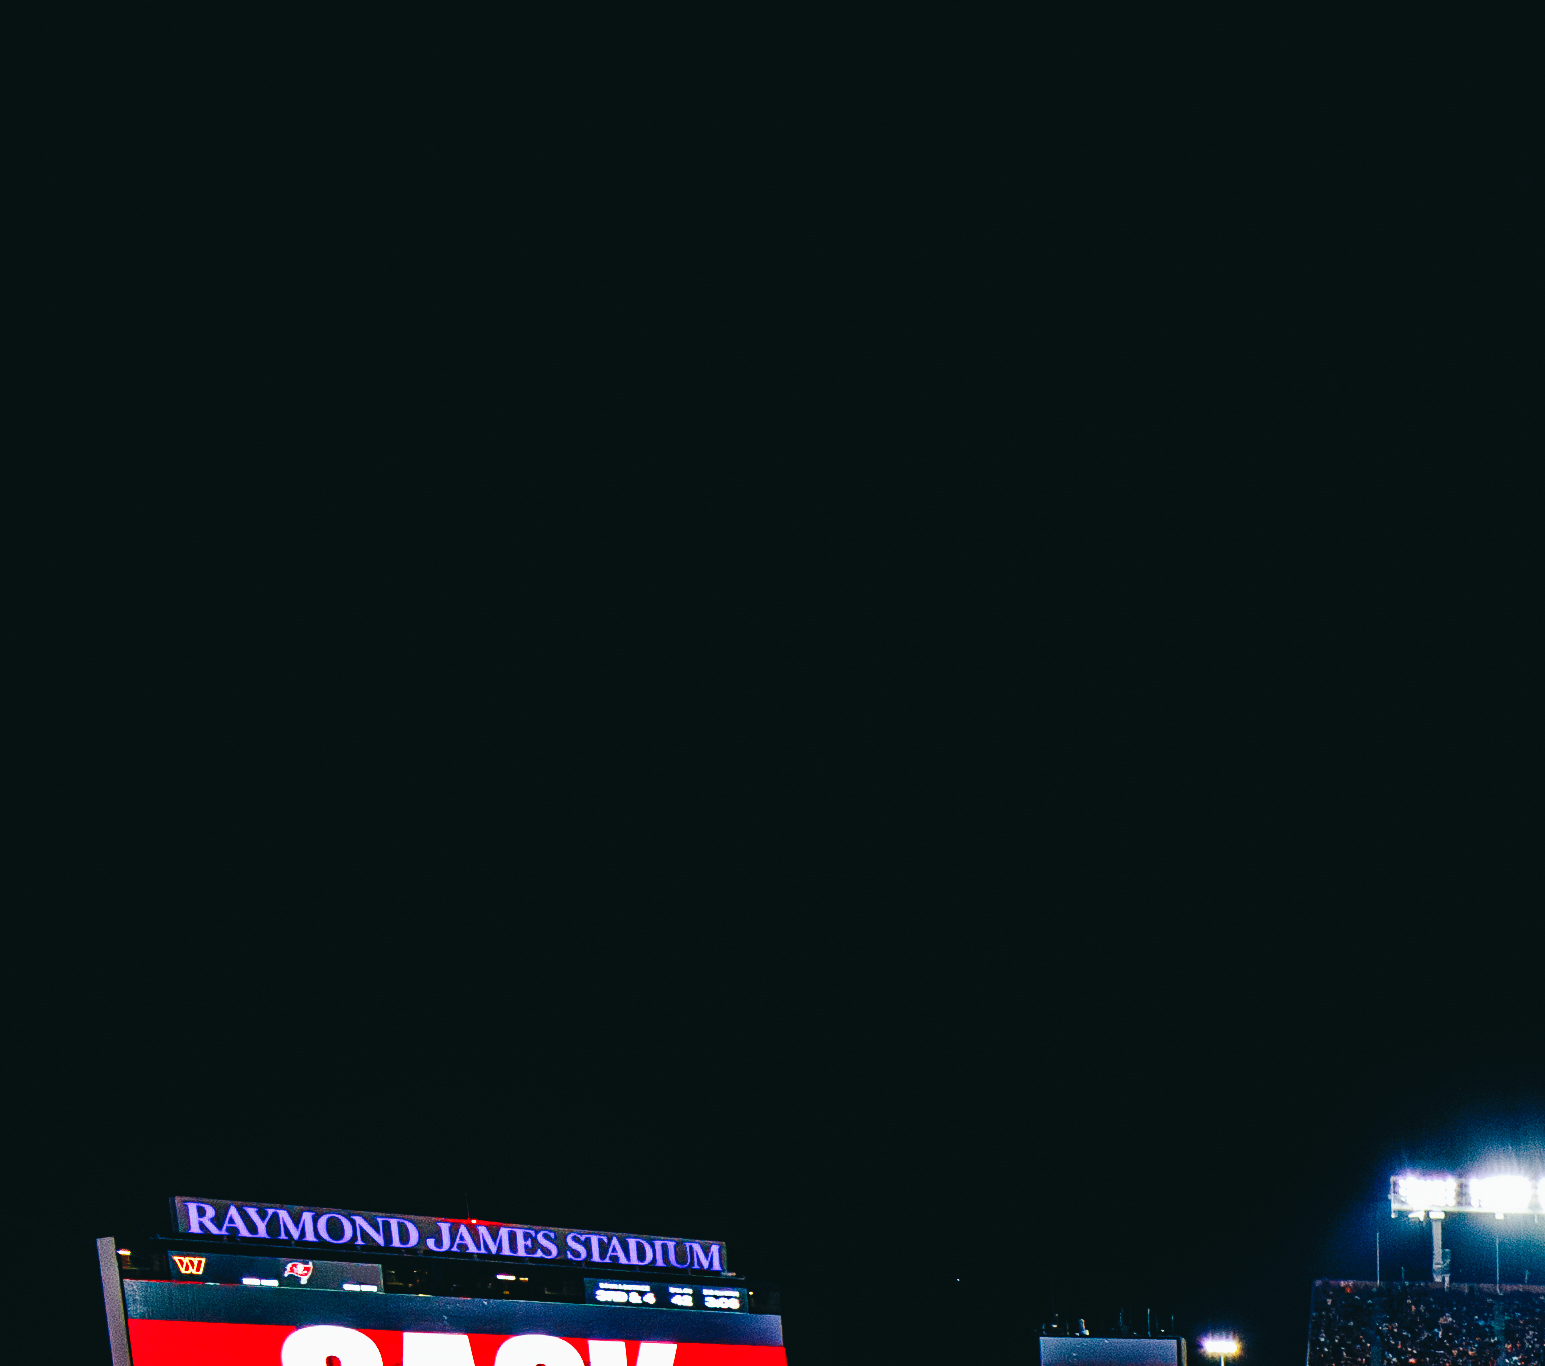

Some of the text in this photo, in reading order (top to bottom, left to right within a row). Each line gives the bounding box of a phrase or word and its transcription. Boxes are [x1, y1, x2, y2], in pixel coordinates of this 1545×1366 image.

[183, 1201, 723, 1271] RAYMOND JAMES STADIUM
